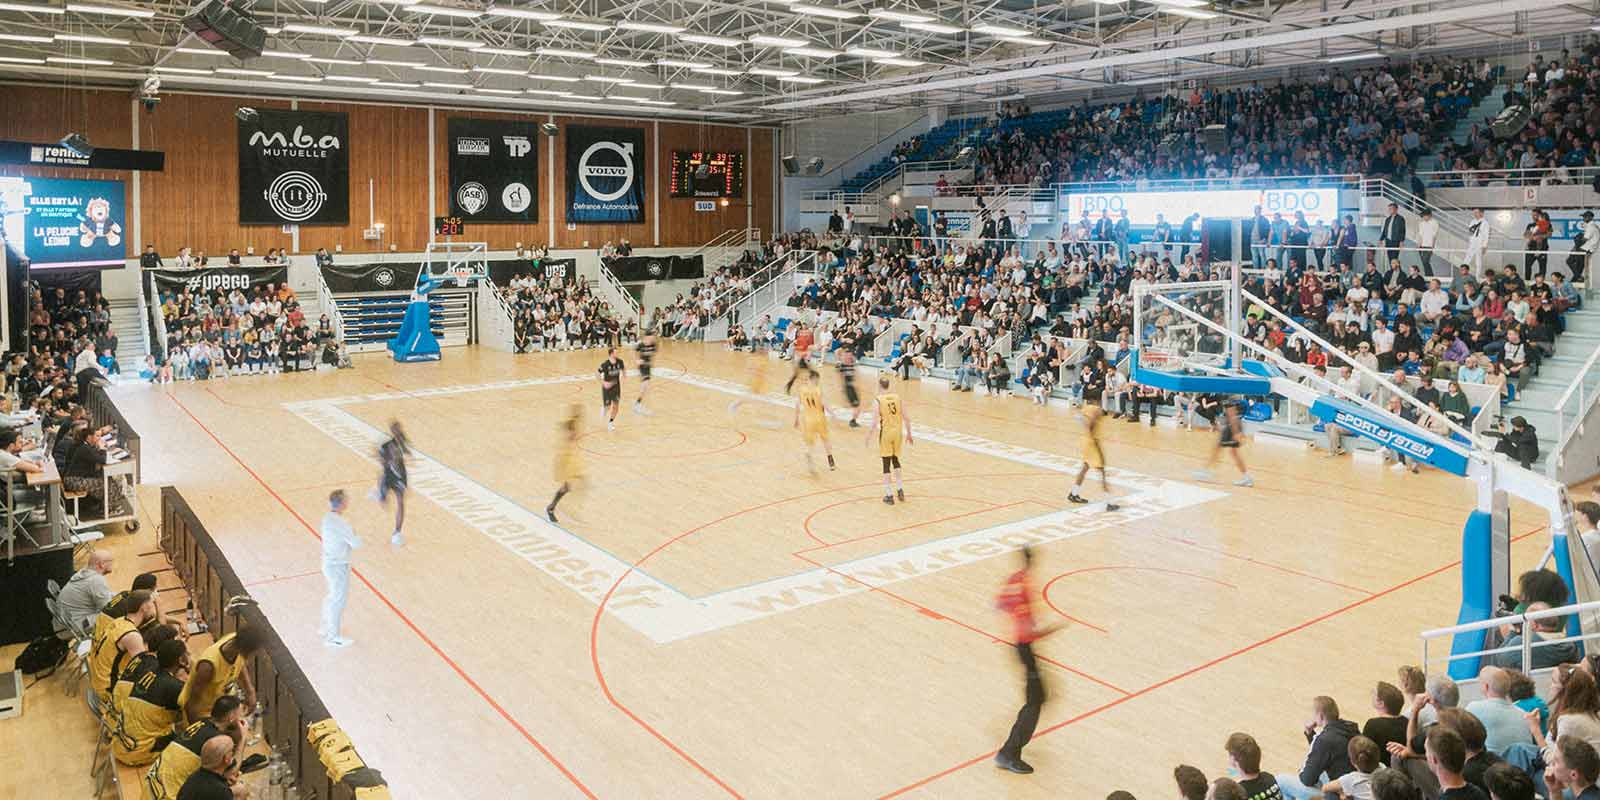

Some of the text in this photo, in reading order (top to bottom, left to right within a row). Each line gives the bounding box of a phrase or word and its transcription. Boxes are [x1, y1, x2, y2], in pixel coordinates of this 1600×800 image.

[249, 125, 340, 149] m.b.a
[263, 149, 327, 158] MUTUELLE
[692, 152, 703, 160] 49
[716, 153, 727, 161] 39
[464, 191, 481, 199] ASB
[1267, 192, 1321, 210] BDO
[1084, 195, 1124, 212] BDO
[34, 226, 45, 237] LA
[442, 224, 457, 235] 20
[545, 263, 567, 278] UPB
[887, 402, 897, 415] 13
